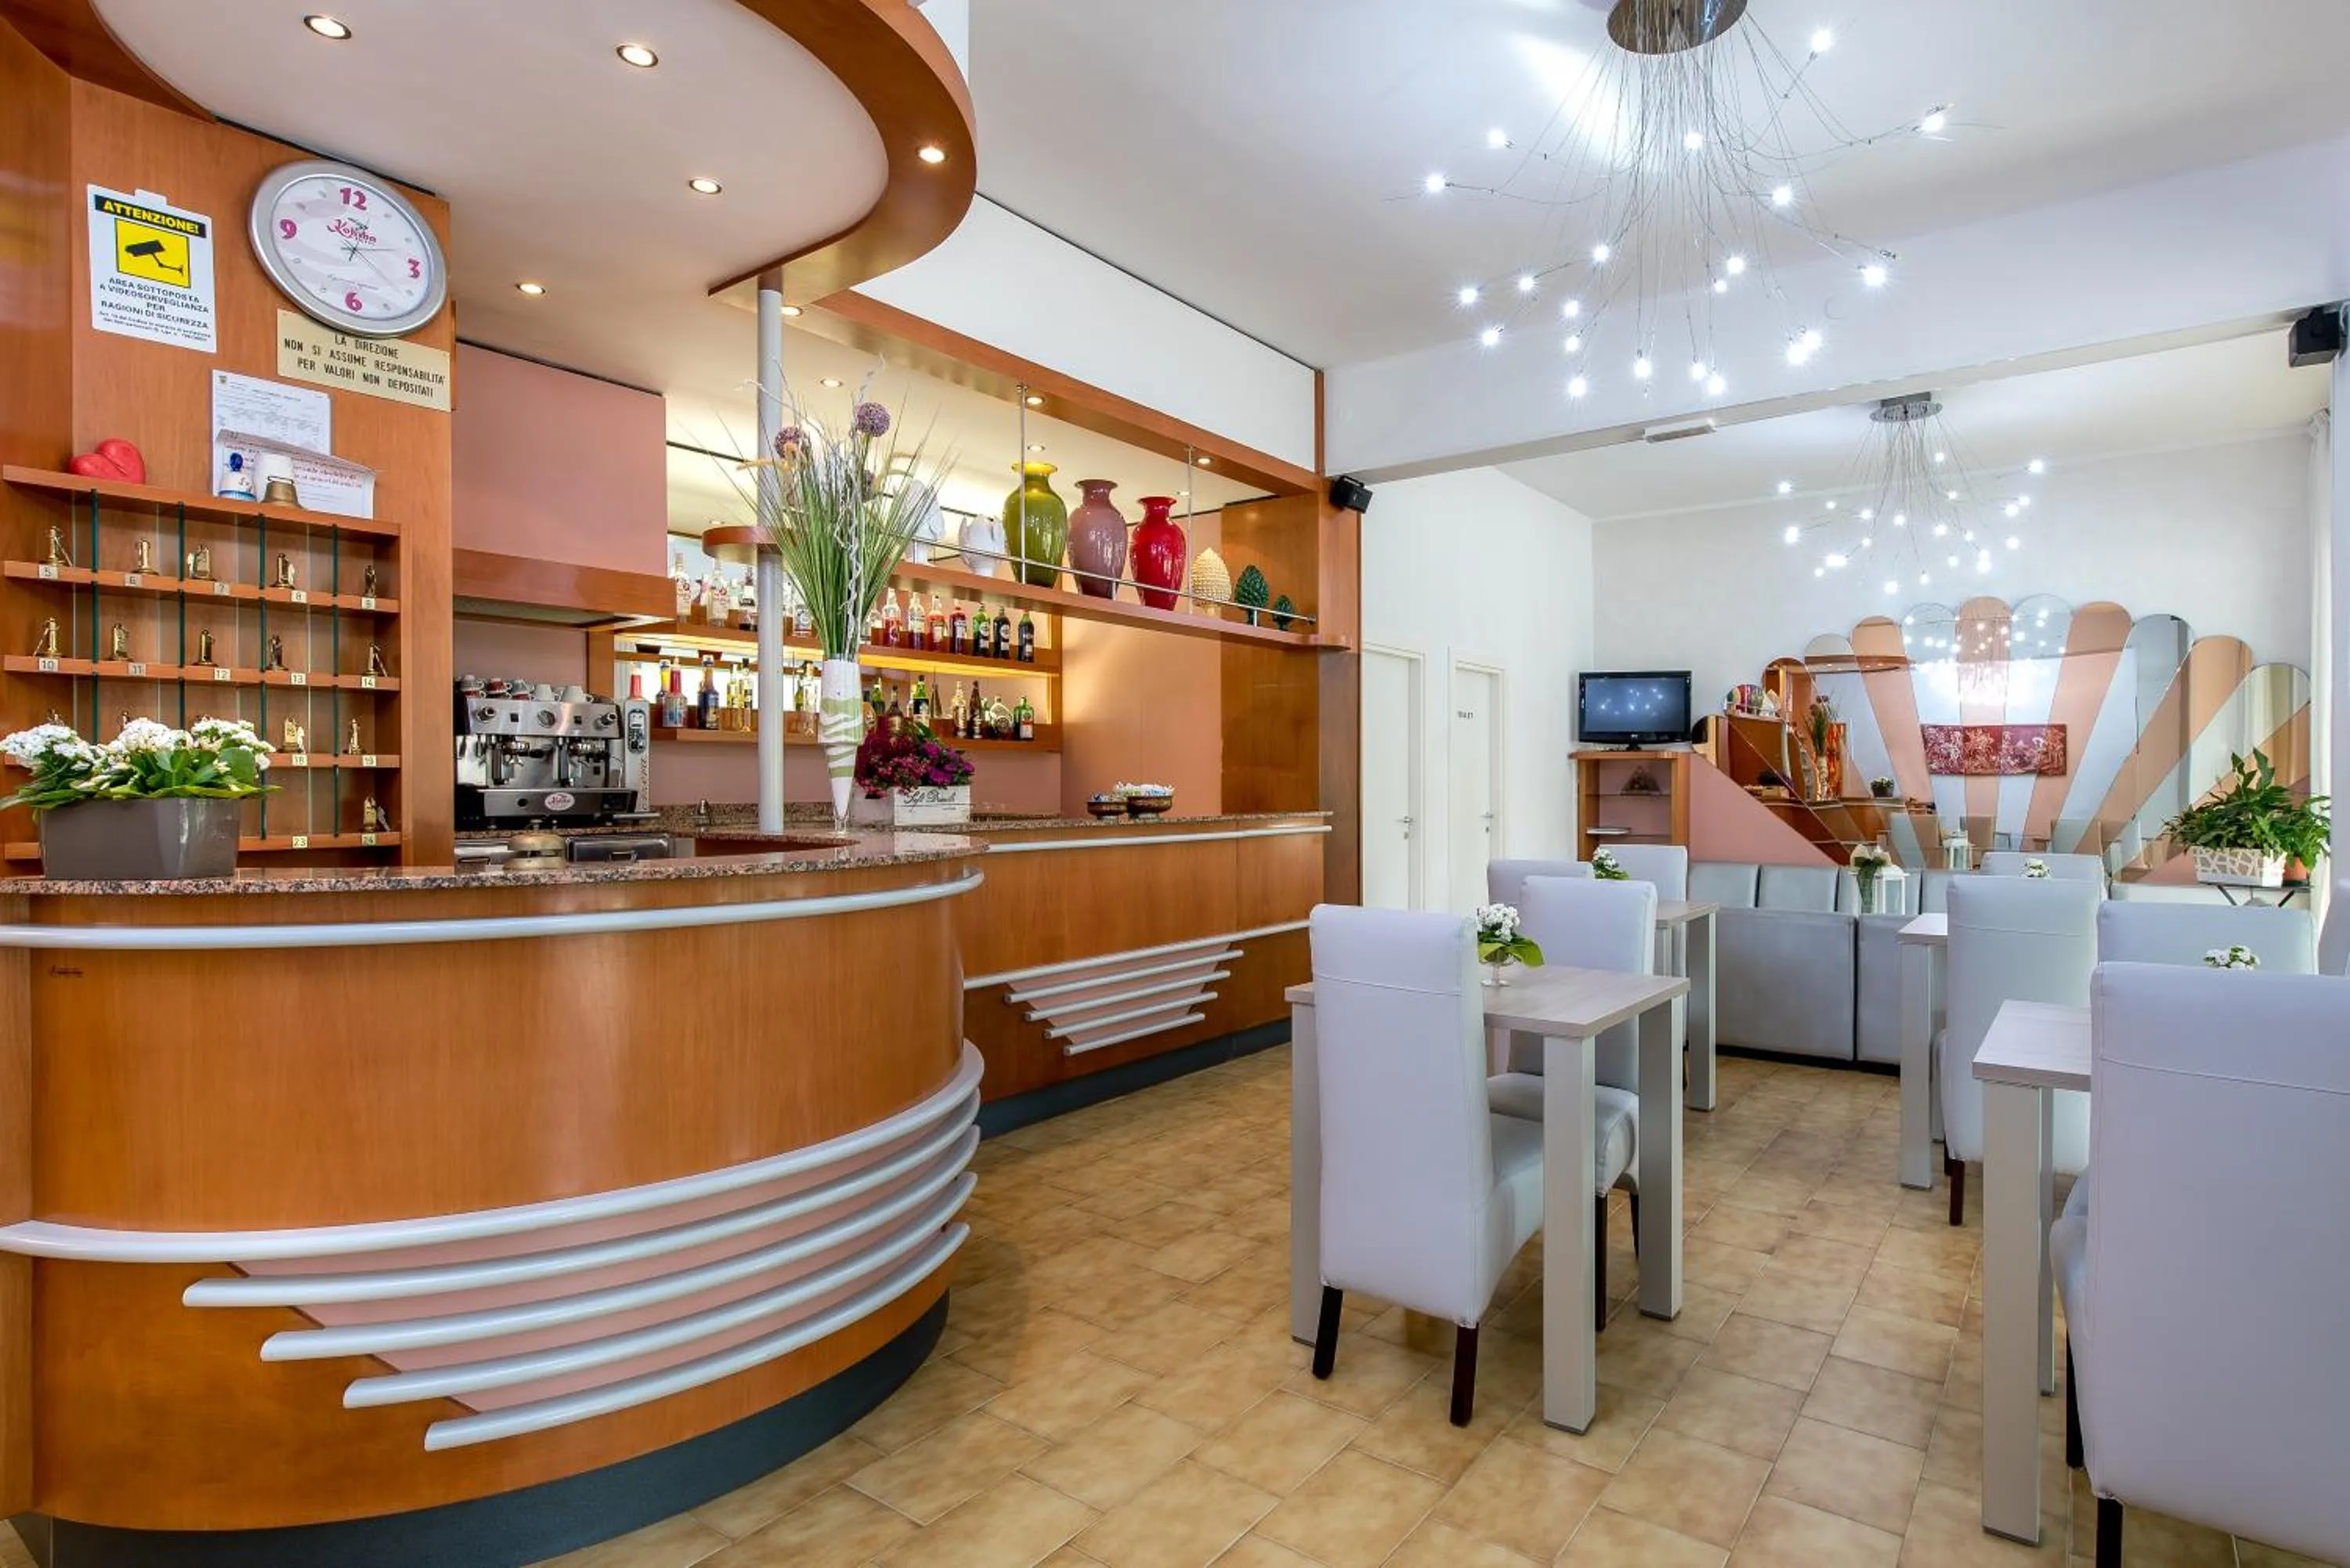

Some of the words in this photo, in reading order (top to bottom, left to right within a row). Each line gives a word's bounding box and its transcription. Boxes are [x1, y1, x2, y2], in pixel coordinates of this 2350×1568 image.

[339, 187, 367, 211] 12
[103, 200, 200, 234] ATTENZIONE!
[280, 219, 297, 240] 9
[407, 258, 421, 279] 3
[107, 284, 209, 313] VIDEOSORVEGLIANZA
[109, 276, 136, 289] AREA
[136, 284, 200, 304] SOTTOPOSTA
[146, 302, 166, 313] PER
[344, 291, 363, 312] 6
[100, 300, 144, 316] RAGIONI
[145, 309, 155, 318] DI
[156, 312, 209, 330] SICUREZZA
[334, 334, 347, 346] LA
[354, 339, 400, 359] DIREZIONE
[284, 338, 304, 352] NON
[312, 345, 321, 356] SI
[329, 349, 367, 367] ASSUME
[374, 360, 446, 386] RESPONSABILITA'
[297, 357, 316, 371] PER
[323, 363, 356, 381] VALORI
[363, 372, 381, 386] NON
[388, 378, 434, 398] DEPOSITATI
[44, 566, 52, 578] 5
[41, 659, 55, 670] 10
[132, 665, 143, 675] 11
[216, 670, 229, 681] 12
[293, 674, 304, 685] 13
[363, 678, 374, 688] 14
[294, 837, 306, 847] 23
